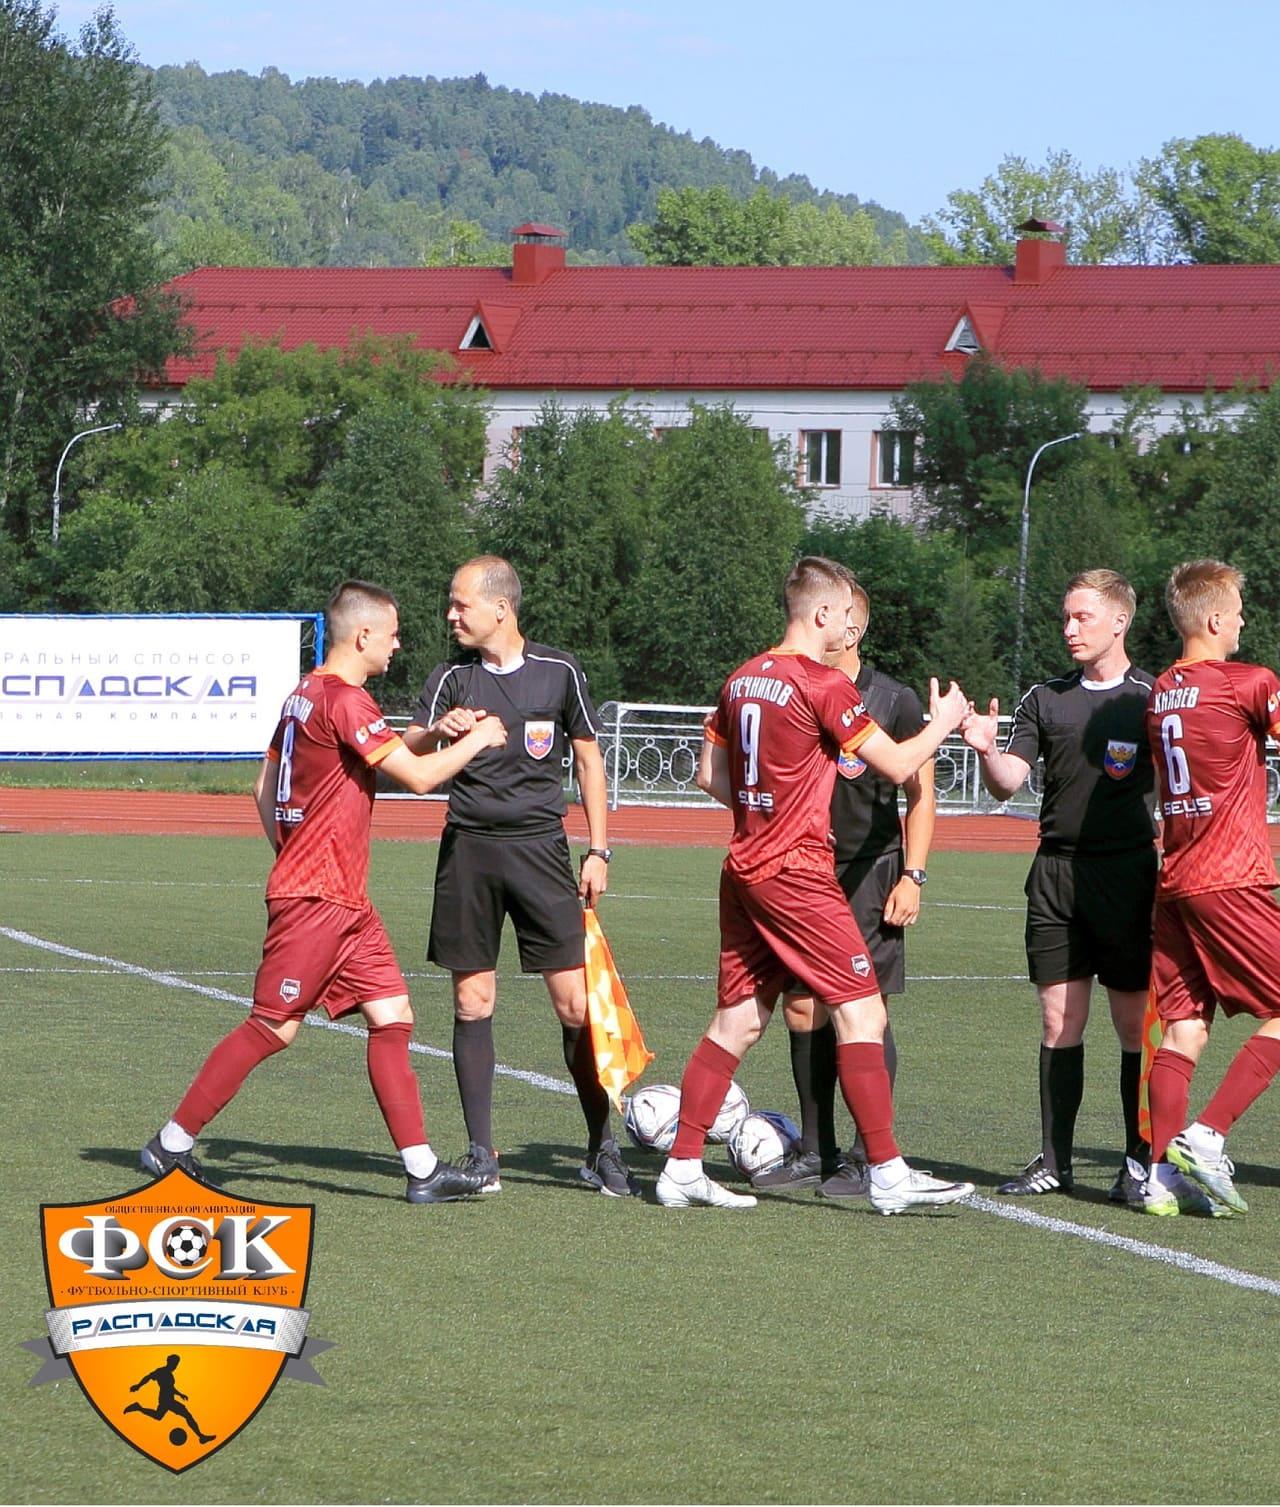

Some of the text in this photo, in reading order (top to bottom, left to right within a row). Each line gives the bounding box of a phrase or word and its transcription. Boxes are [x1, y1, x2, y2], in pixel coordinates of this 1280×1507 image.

[134, 652, 250, 664] СПОНСОР
[110, 711, 257, 720] КОМПАНИЯ
[740, 703, 762, 786] 9
[276, 719, 295, 803] 8
[1161, 714, 1192, 795] 6
[738, 790, 774, 807] SUS
[1163, 797, 1212, 816] SEUS
